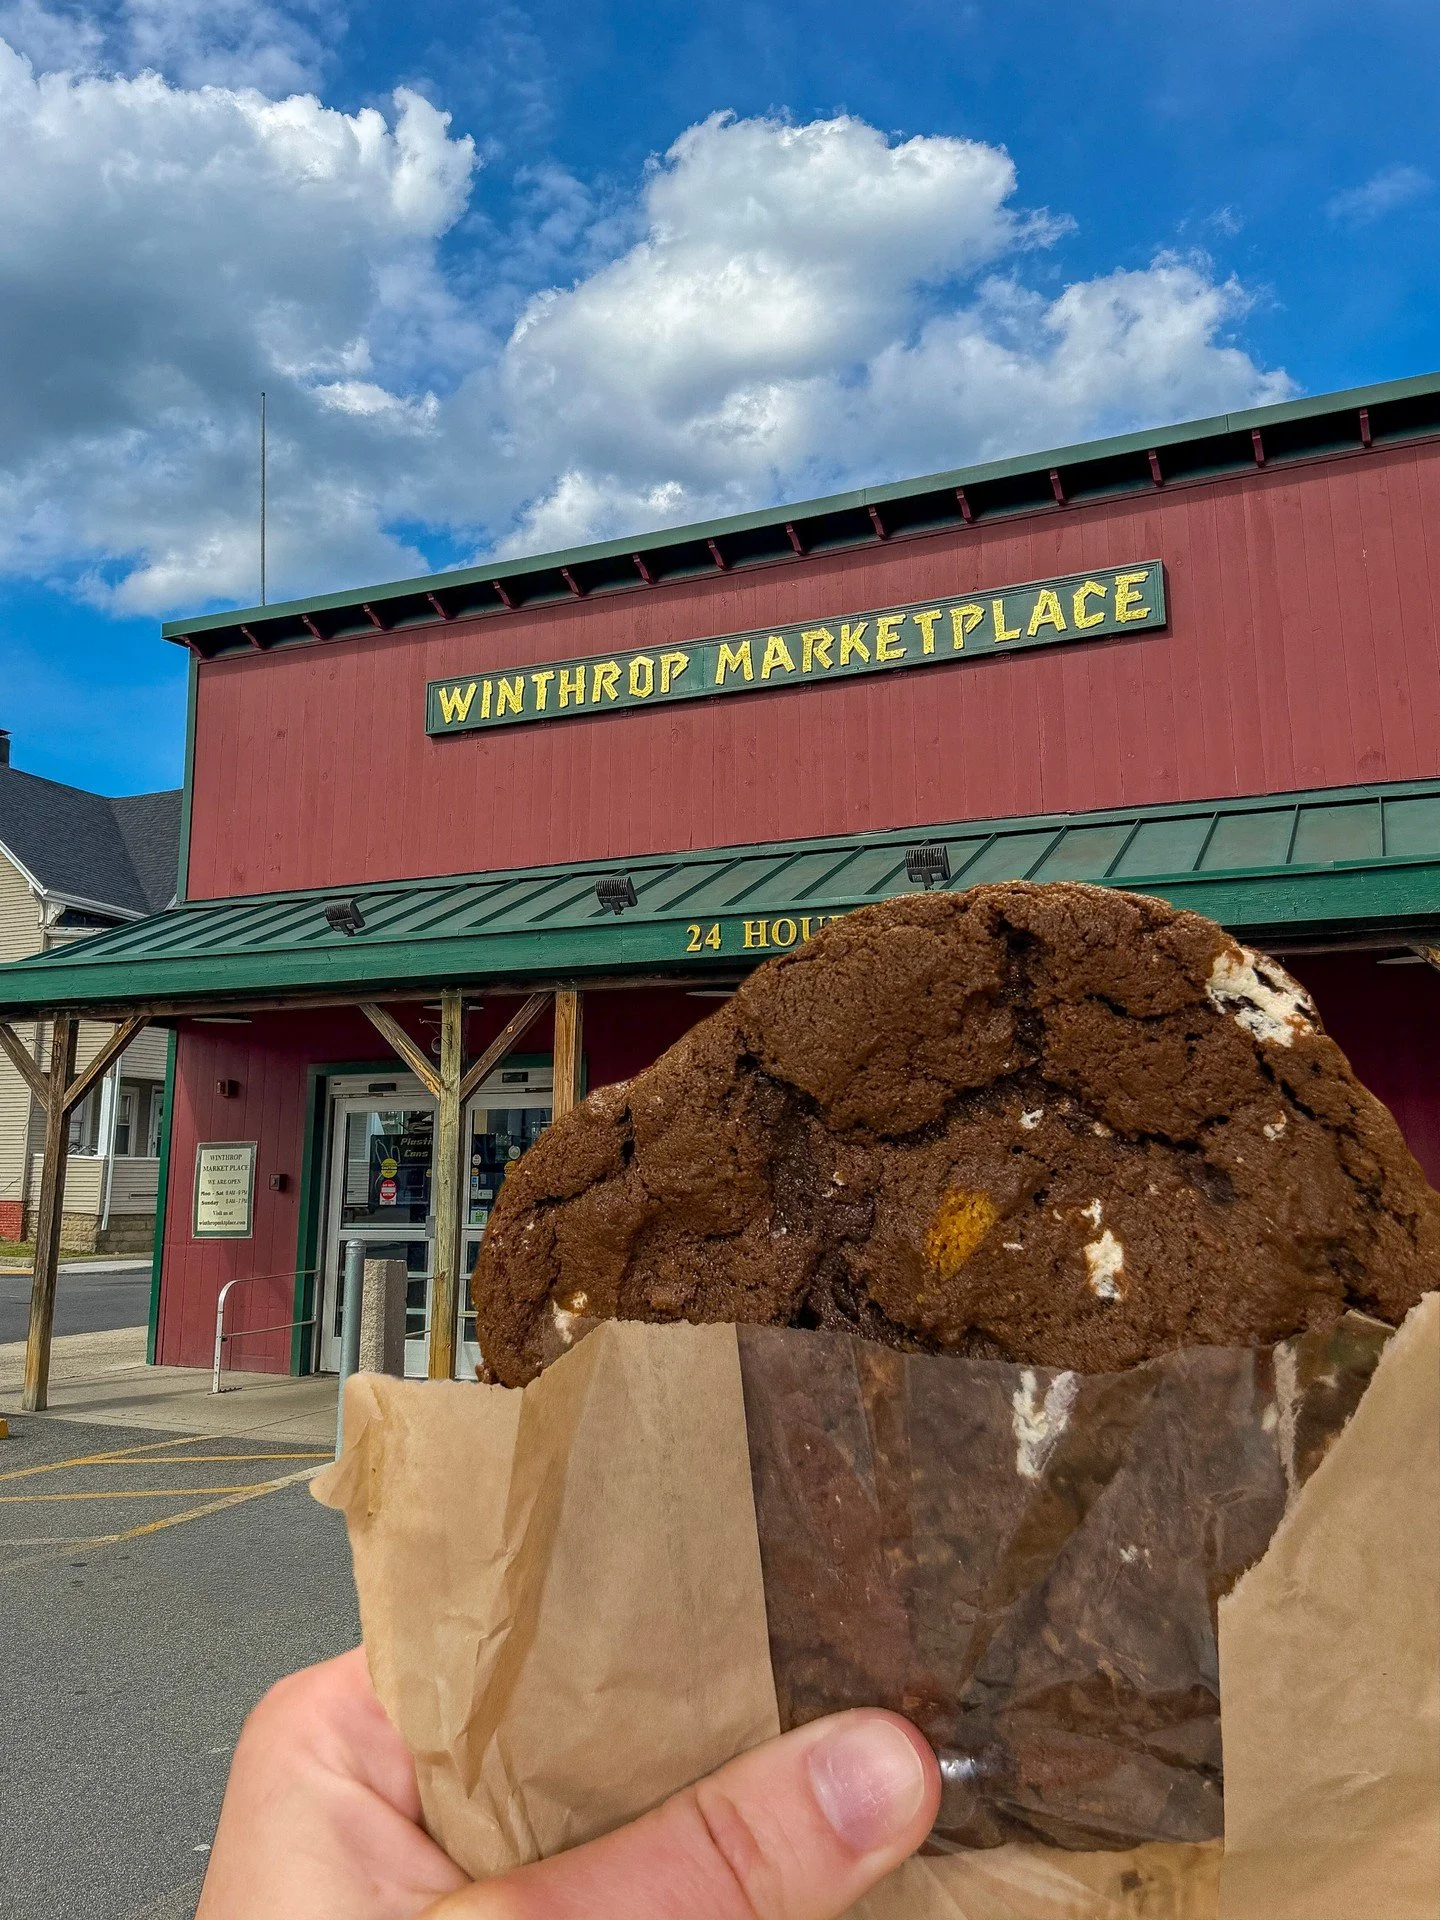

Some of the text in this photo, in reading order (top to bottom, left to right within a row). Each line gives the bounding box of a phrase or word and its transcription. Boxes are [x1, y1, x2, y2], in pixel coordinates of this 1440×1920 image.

[438, 571, 1151, 724] WINTHROP MARKETPLACE
[686, 915, 847, 952] 24 HOU
